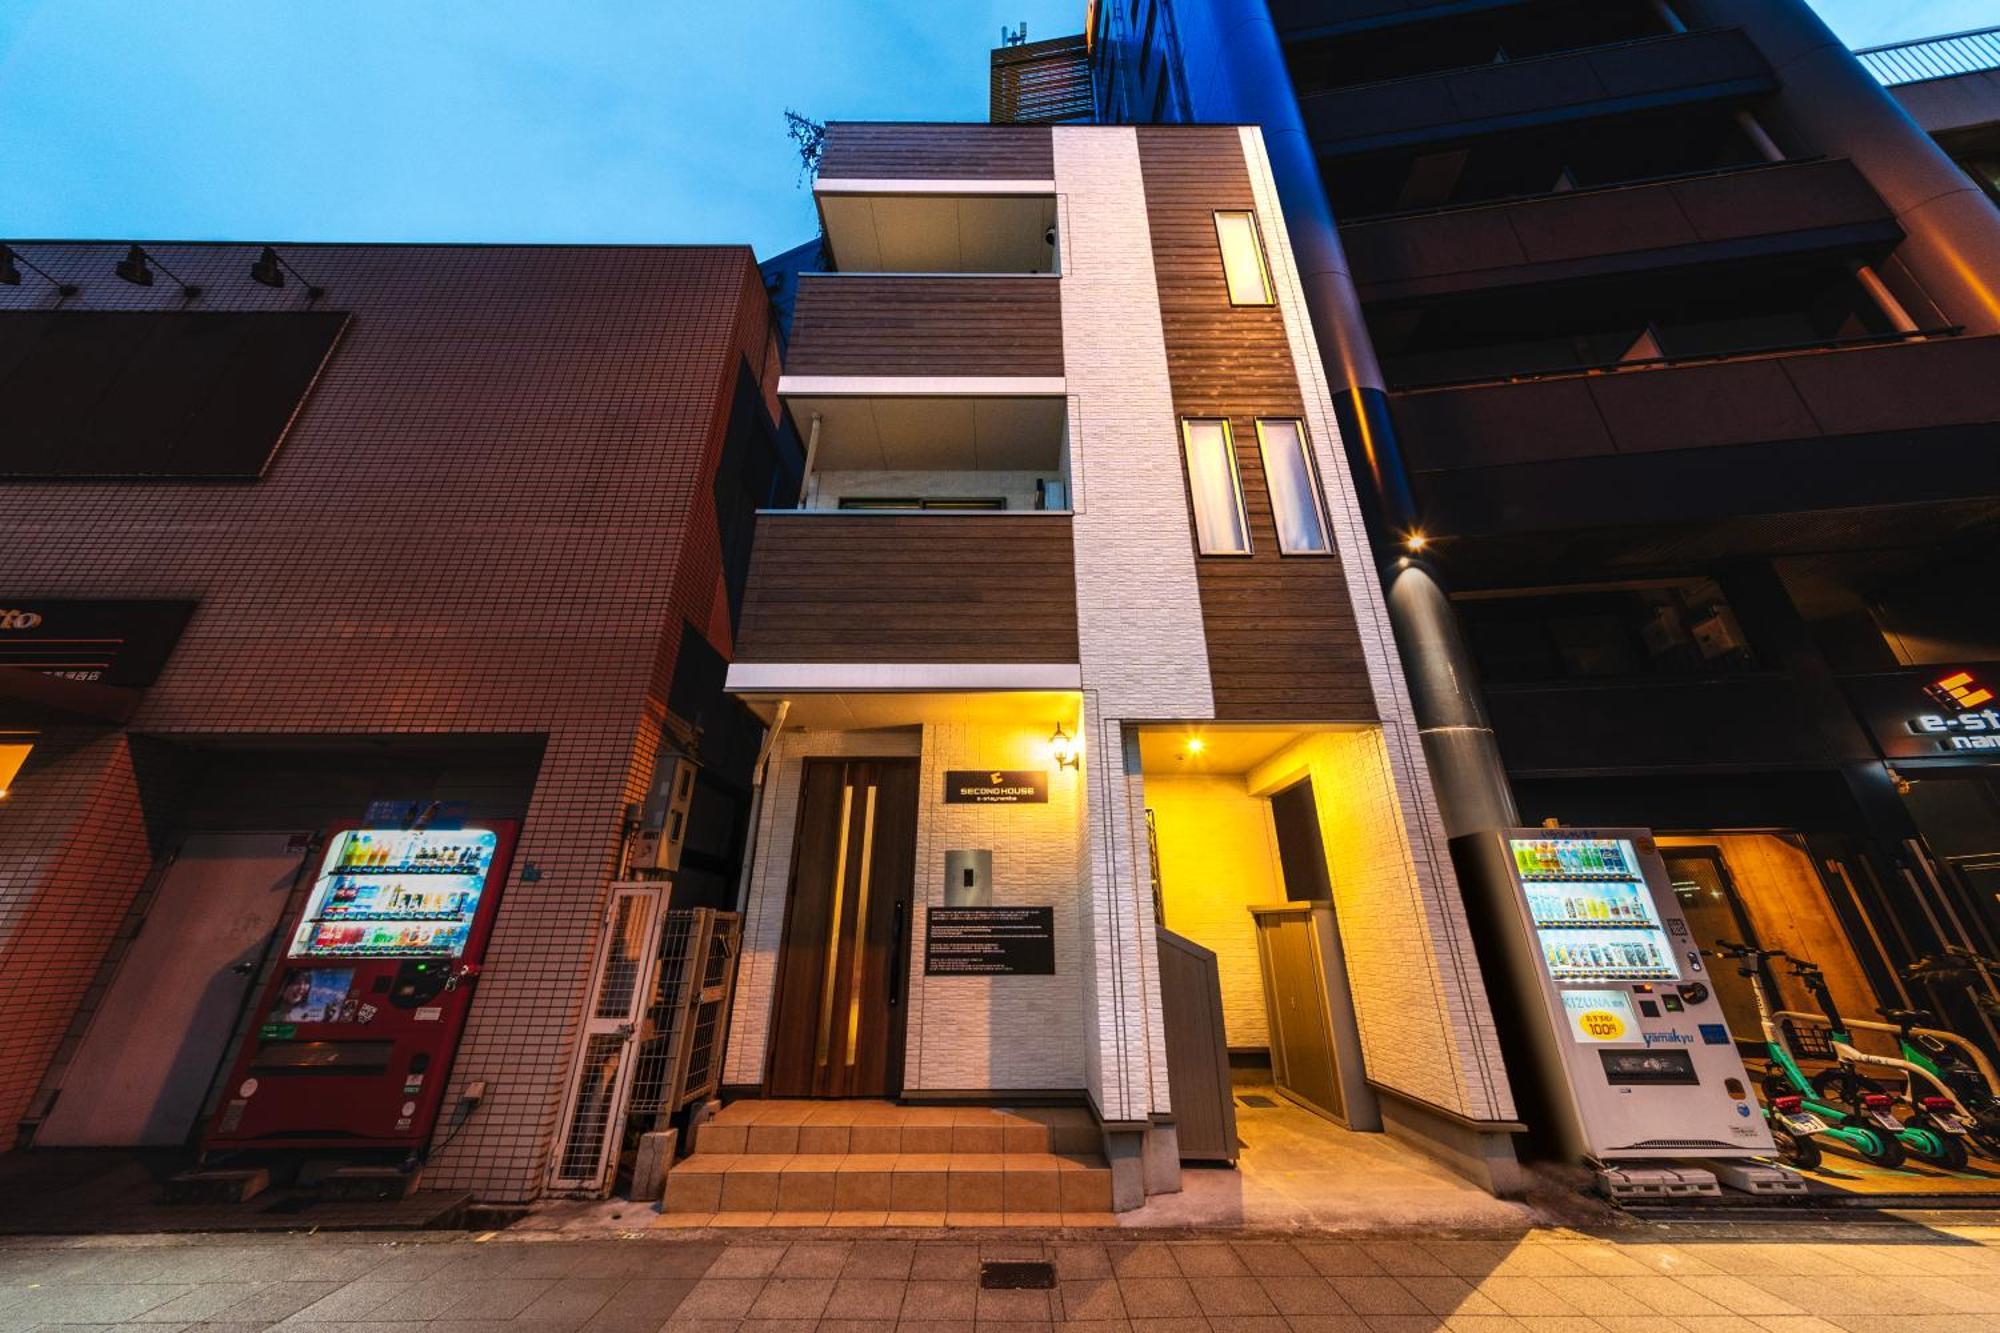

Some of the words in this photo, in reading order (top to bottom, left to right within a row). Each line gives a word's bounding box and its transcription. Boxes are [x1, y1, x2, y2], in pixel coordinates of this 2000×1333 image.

[960, 787, 1000, 796] SECOND
[1000, 787, 1035, 796] HOUSE
[1643, 1028, 1695, 1049] yamakyu
